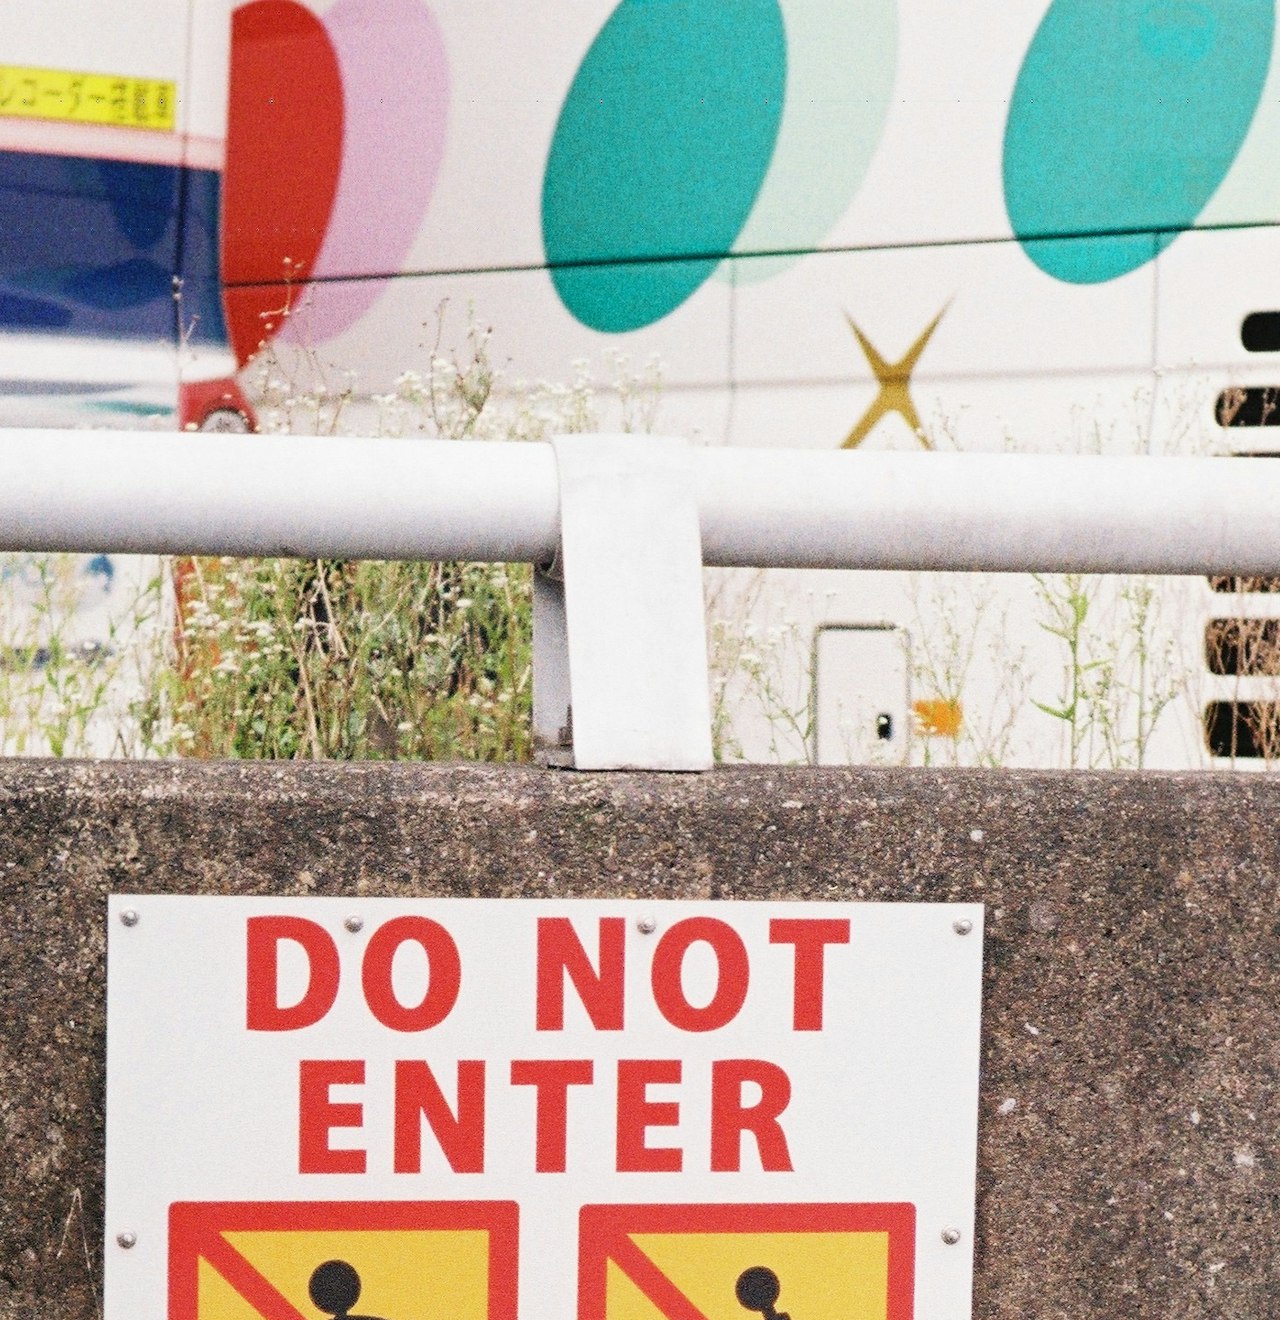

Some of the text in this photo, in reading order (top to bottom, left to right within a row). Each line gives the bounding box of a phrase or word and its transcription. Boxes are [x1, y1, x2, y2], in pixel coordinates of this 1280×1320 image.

[245, 915, 850, 1032] DO NOT
[298, 1058, 794, 1174] ENTER
